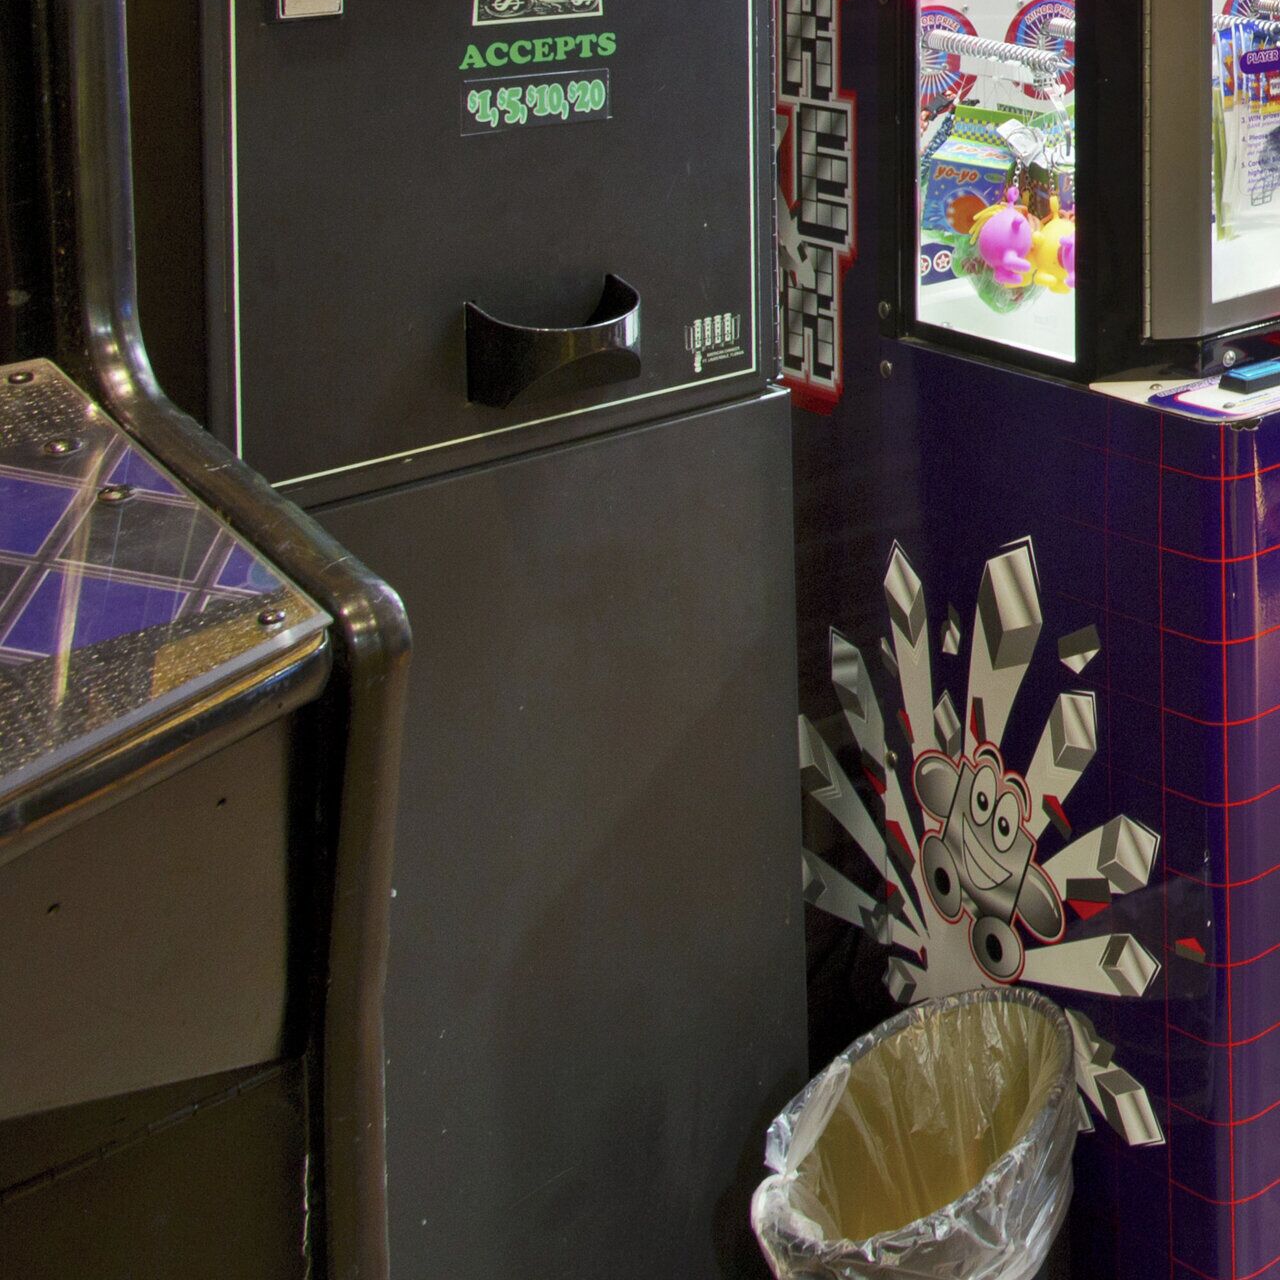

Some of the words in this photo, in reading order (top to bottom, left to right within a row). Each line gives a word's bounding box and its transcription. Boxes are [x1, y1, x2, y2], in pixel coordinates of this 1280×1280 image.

[1024, 4, 1054, 25] MINOR
[458, 32, 617, 70] ACCEPTS
[1246, 49, 1279, 65] PLAYER
[934, 165, 980, 184] yo-yo
